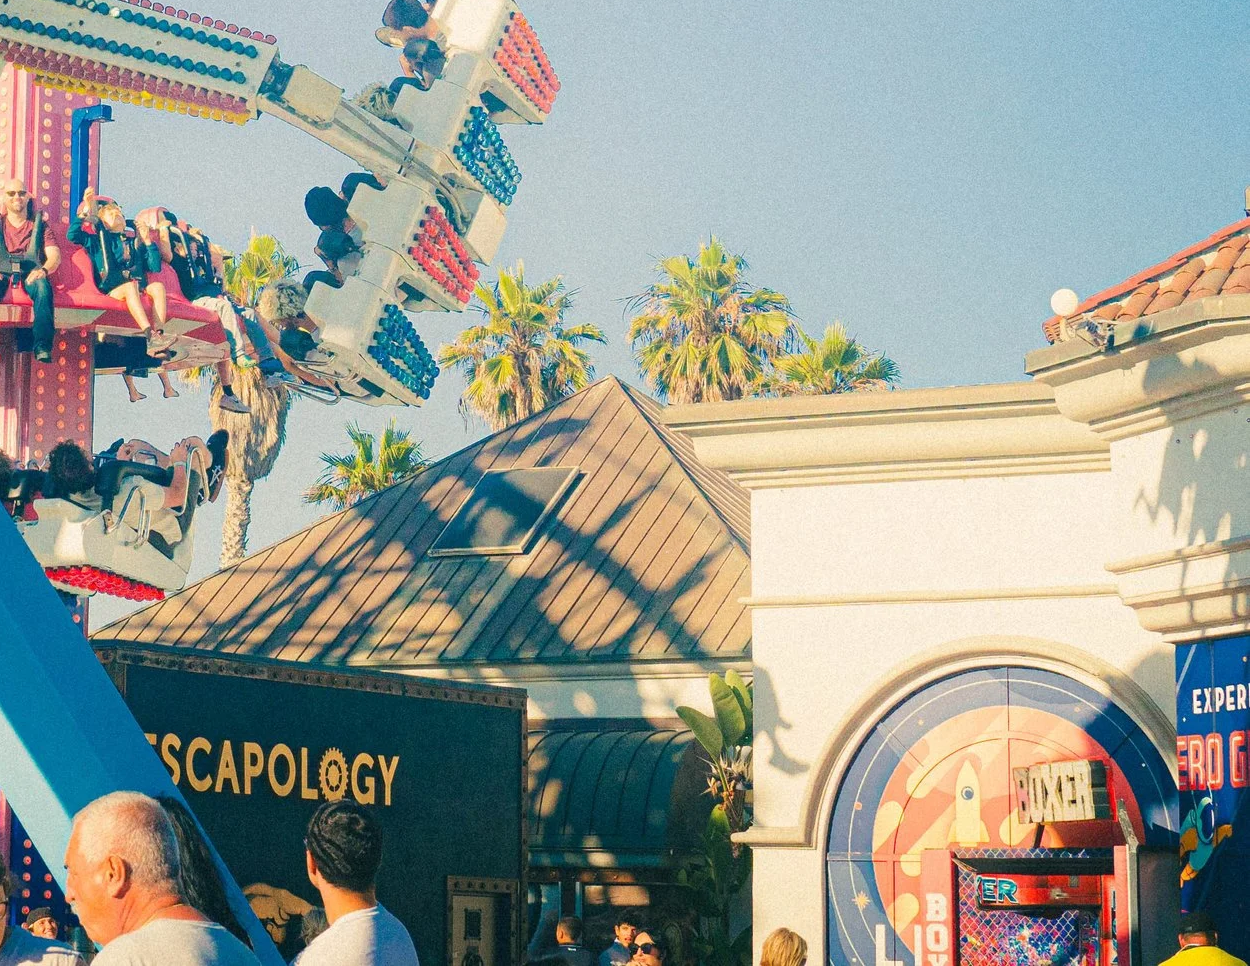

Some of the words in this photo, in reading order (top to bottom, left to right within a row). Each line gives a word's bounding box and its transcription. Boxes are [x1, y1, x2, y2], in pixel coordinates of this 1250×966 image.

[144, 732, 400, 806] SCAPOLOGY
[1013, 759, 1096, 824] BOXER
[1176, 732, 1225, 791] ERO
[1229, 729, 1250, 789] G
[976, 875, 1019, 905] ER
